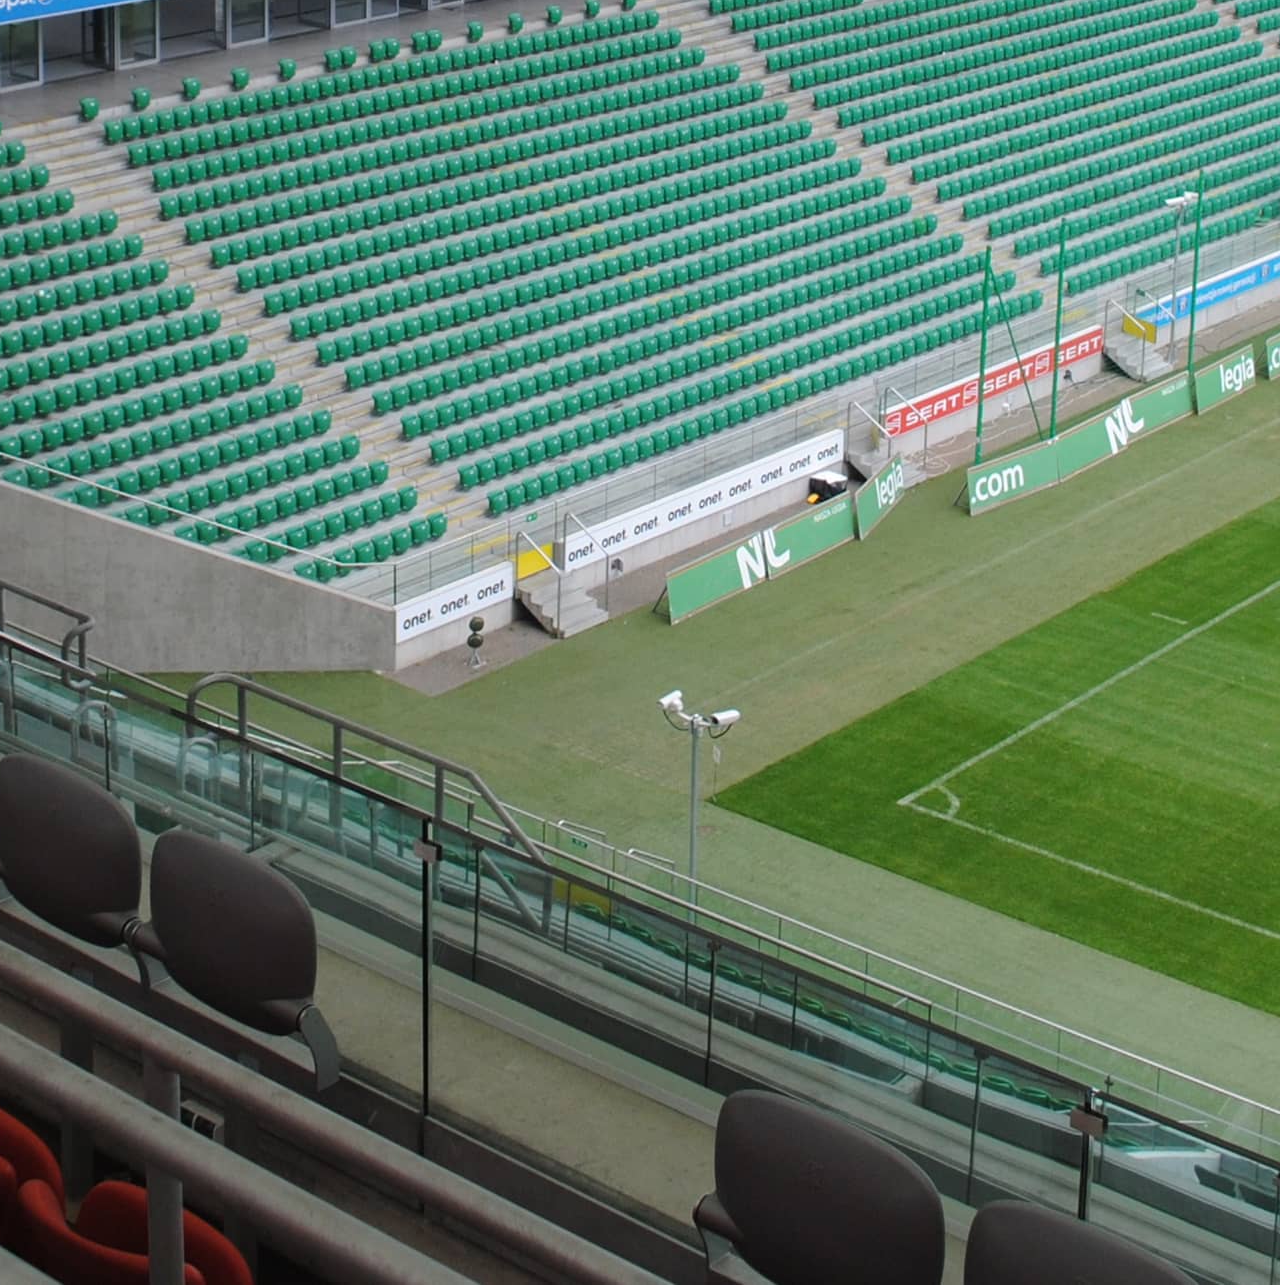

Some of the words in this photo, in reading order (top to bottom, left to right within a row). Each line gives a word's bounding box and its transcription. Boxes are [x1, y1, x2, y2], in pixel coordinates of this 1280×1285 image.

[1056, 334, 1102, 364] SEAT
[982, 363, 1034, 395] SEAT
[1220, 355, 1255, 393] legia
[906, 393, 961, 425] SEAT
[568, 542, 594, 562] onet
[601, 529, 627, 548] onet
[633, 516, 658, 535] onet
[668, 503, 692, 521] onet
[698, 491, 722, 509] onet
[728, 478, 752, 497] onet
[760, 466, 783, 484] onet
[789, 455, 811, 472] onet
[817, 443, 839, 460] onet
[875, 462, 904, 509] legia
[971, 464, 1024, 504] .com
[736, 528, 790, 589] NL
[403, 609, 431, 630] onet
[440, 594, 469, 615] onet
[477, 579, 506, 600] onet
